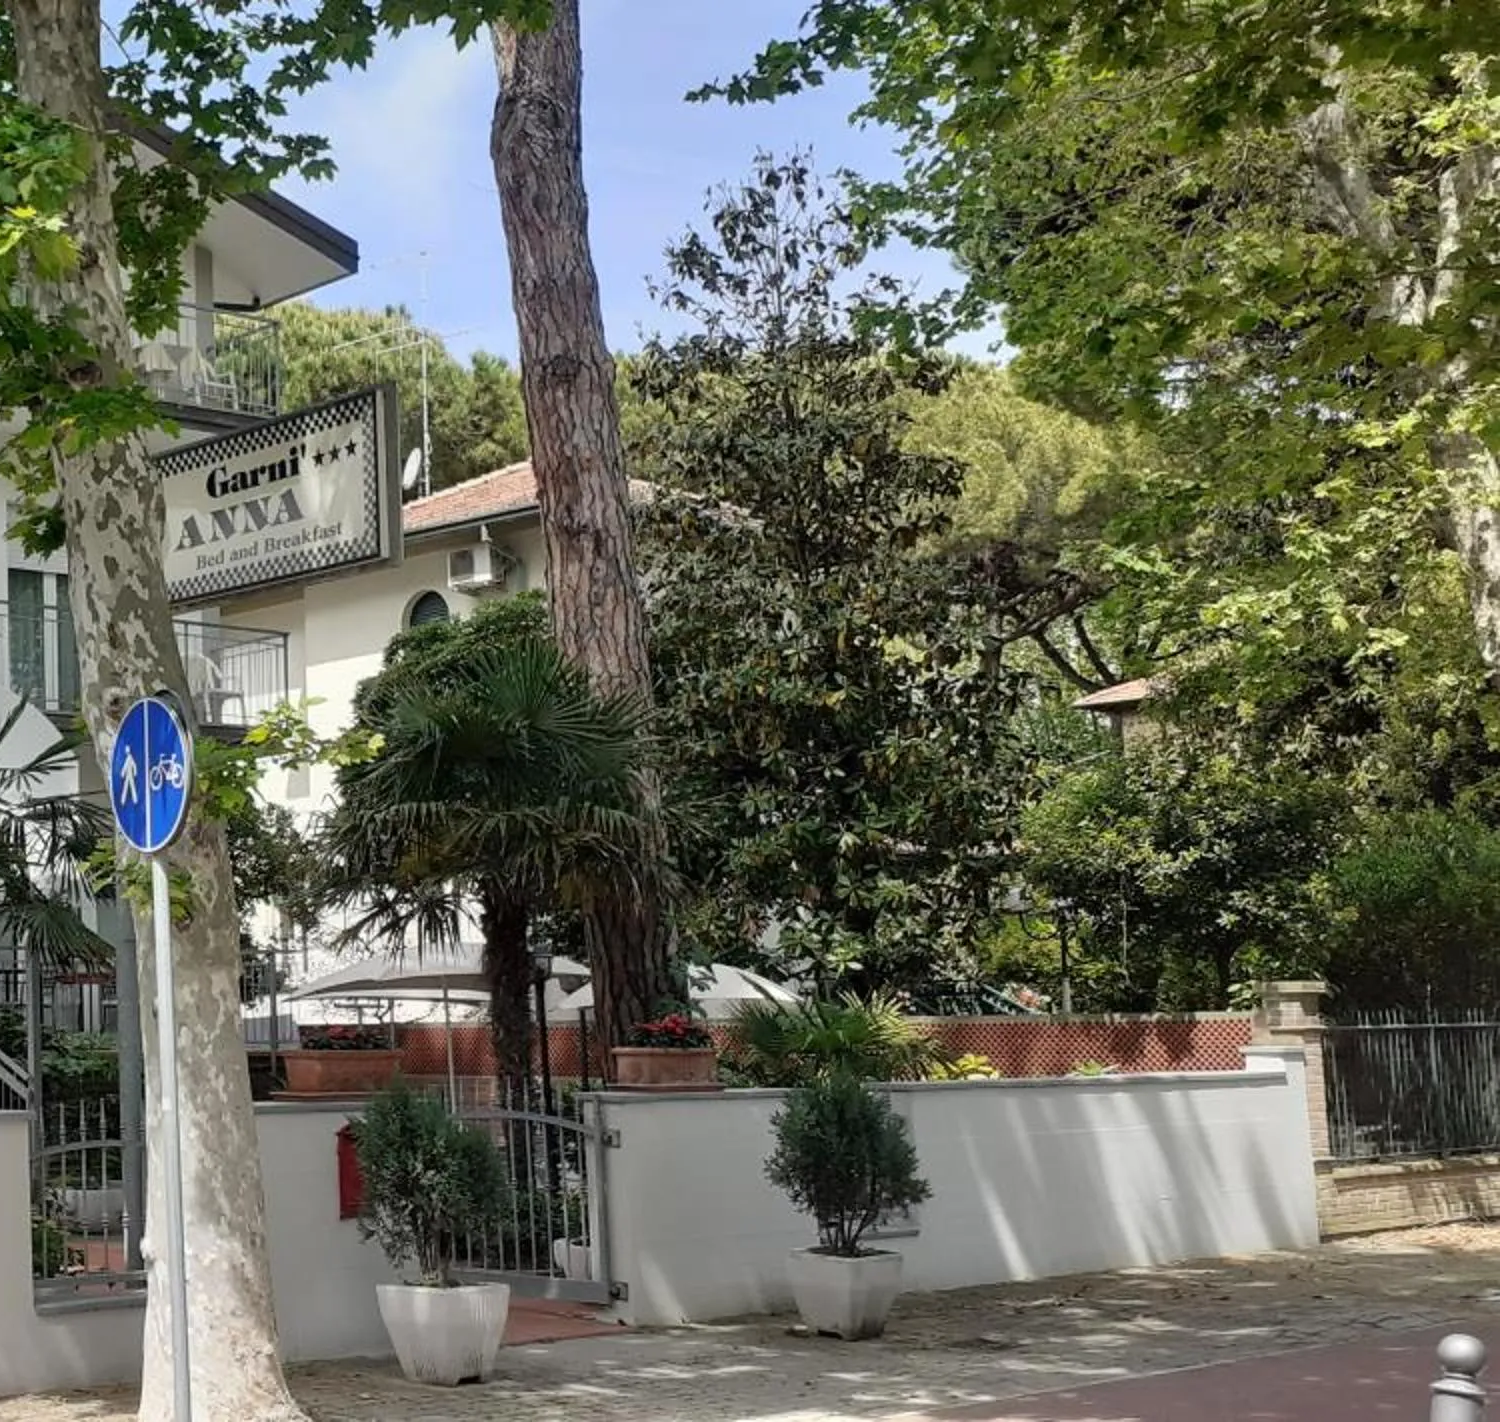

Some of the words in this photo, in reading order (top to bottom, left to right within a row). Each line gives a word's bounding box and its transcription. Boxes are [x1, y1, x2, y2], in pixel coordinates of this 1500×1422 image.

[175, 488, 304, 549] ANNA
[196, 549, 225, 570] Bed
[229, 541, 259, 562] and
[264, 522, 342, 552] Breakfast
